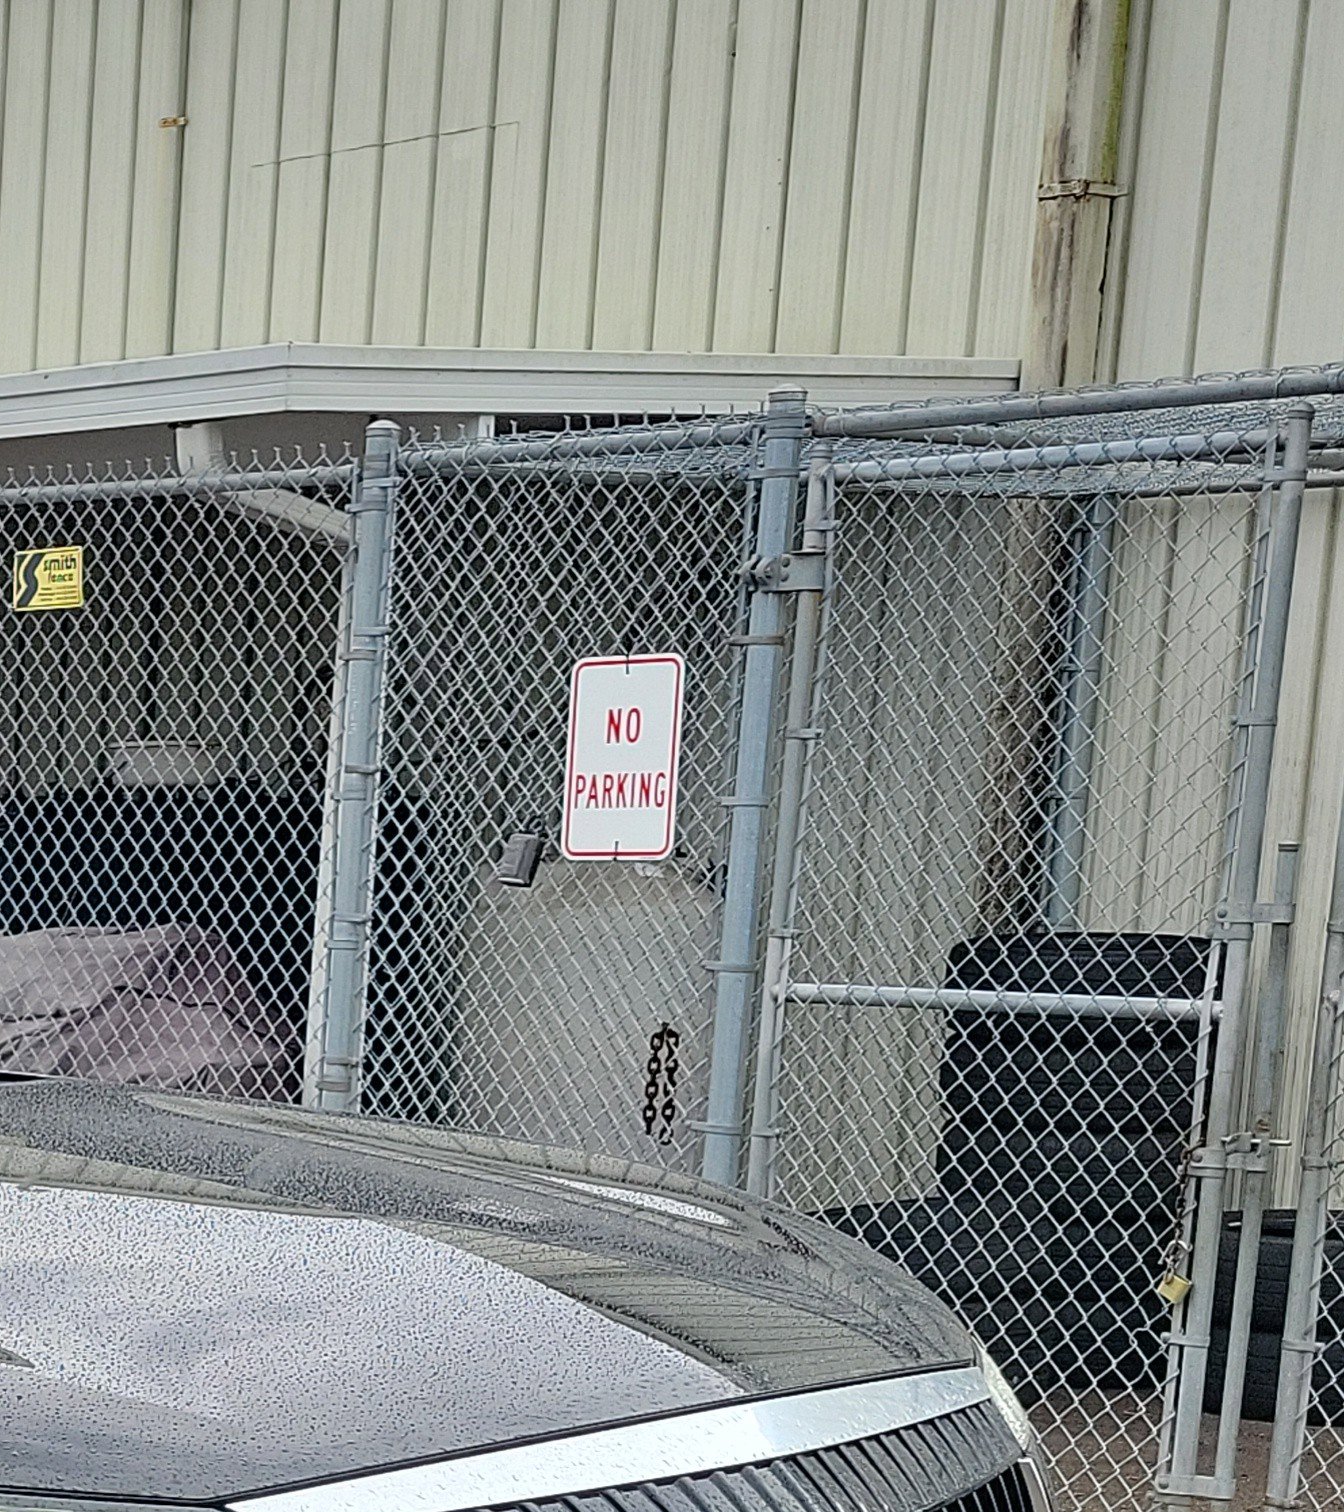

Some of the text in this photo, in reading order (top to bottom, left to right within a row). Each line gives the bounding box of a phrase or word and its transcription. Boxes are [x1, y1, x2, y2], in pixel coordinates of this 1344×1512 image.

[43, 553, 77, 572] smith
[606, 707, 642, 744] NO
[574, 772, 666, 810] PARKING
